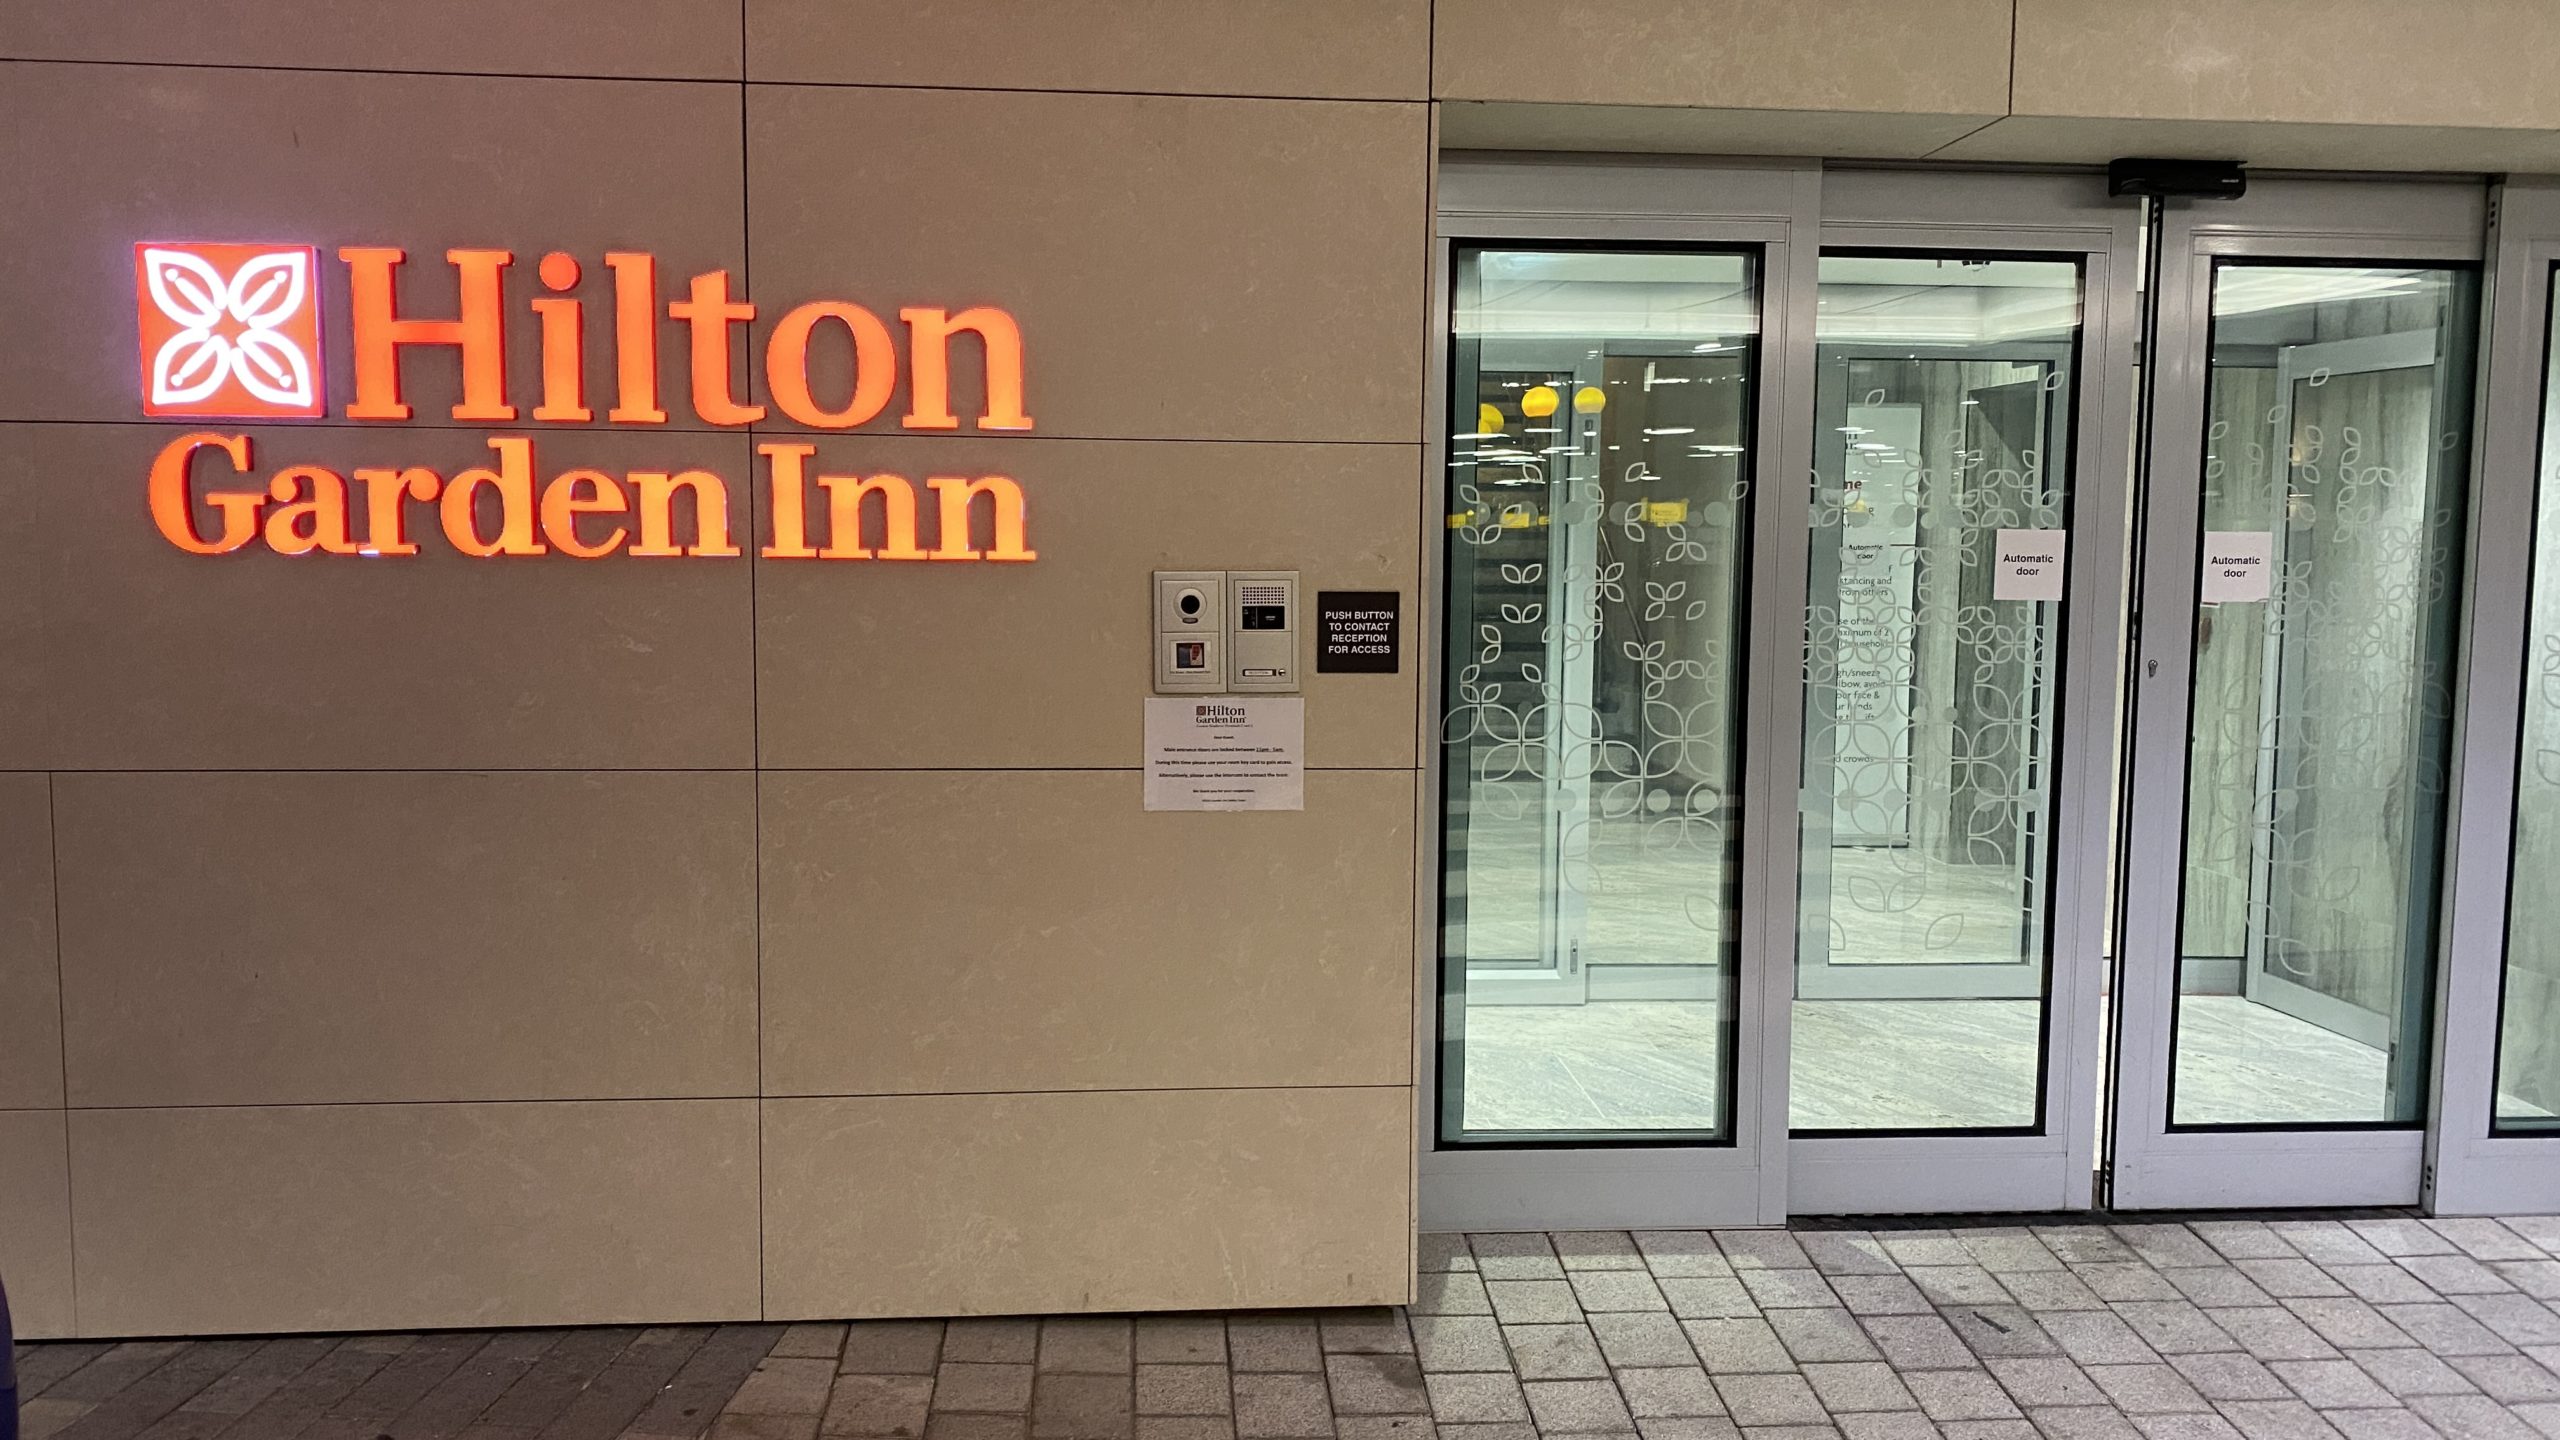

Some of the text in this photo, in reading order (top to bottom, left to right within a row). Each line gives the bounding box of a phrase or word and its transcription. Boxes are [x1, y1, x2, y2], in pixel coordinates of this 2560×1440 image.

[338, 246, 1034, 430] Hilton
[148, 433, 1038, 562] Garden Inn
[2003, 554, 2054, 564] Automatic
[2211, 556, 2261, 566] Automatic
[2016, 566, 2040, 576] door
[2223, 568, 2247, 578] door
[1877, 576, 1892, 585] and
[1325, 611, 1394, 620] PUSH BUTTON
[1329, 622, 1390, 631] TO CONTACT
[1331, 634, 1387, 642] RECEPTION
[1328, 645, 1391, 654] FOR ACCESS
[1207, 705, 1246, 716] Hilton
[1196, 716, 1229, 724] Garden
